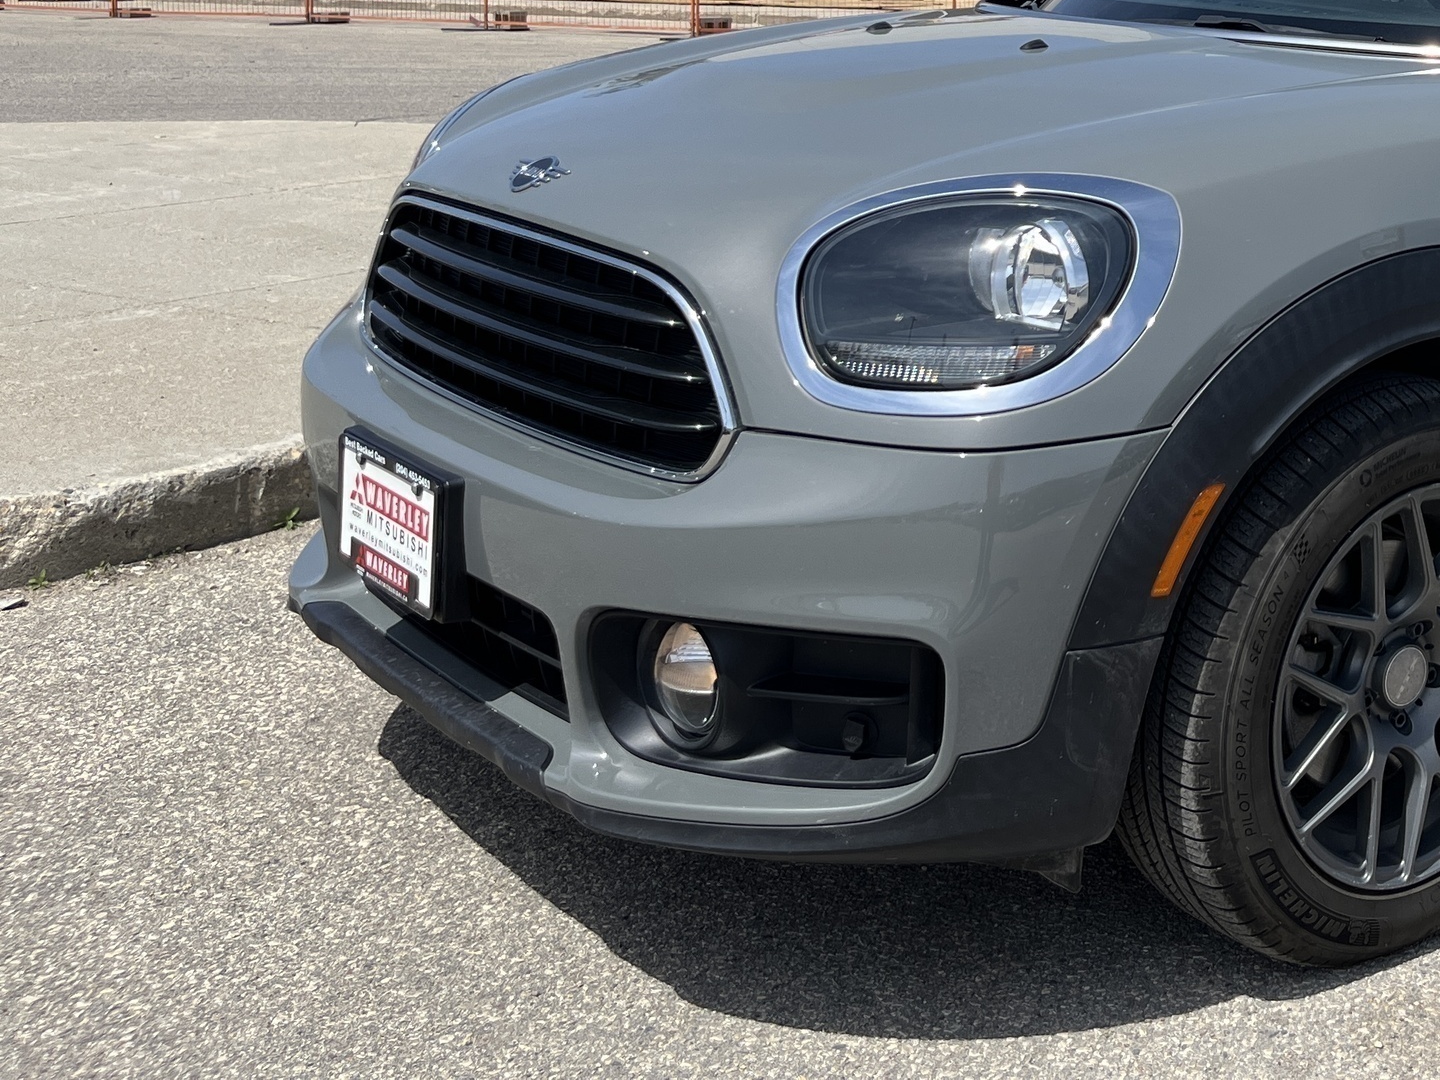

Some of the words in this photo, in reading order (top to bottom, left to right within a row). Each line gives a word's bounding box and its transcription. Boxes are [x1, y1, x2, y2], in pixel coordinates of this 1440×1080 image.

[344, 436, 356, 450] Best
[356, 441, 374, 459] Backed
[374, 451, 386, 465] Cars
[365, 479, 429, 537] WAVERLEY
[366, 508, 428, 560] MITSUBISHI
[349, 522, 428, 578] waverleymitsubishi.com
[365, 549, 409, 590] WAVERLEY
[1250, 585, 1284, 664] SEASON
[1240, 675, 1256, 711] ALL
[1235, 720, 1248, 781] SPORT
[1238, 790, 1256, 837] PILOT
[1255, 853, 1346, 938] MICHELIN
